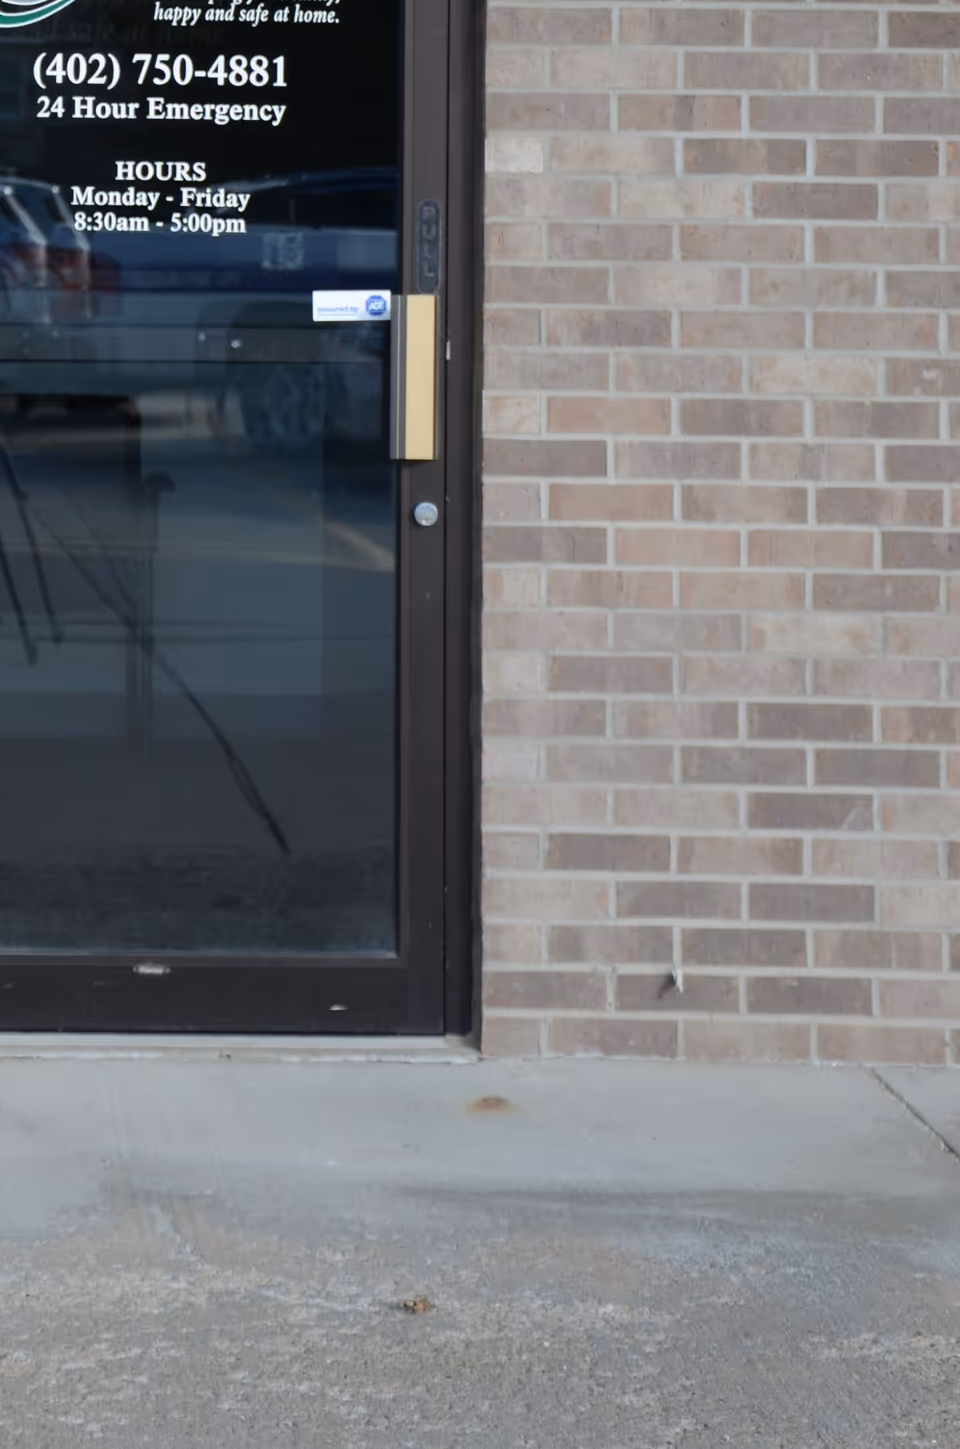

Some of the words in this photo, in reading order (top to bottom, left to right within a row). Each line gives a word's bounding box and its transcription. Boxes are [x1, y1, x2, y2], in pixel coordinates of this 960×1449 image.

[153, 1, 202, 27] happy
[205, 3, 236, 23] and
[238, 3, 270, 28] safe
[273, 6, 290, 23] at
[293, 3, 341, 24] home.
[33, 52, 121, 90] (402)
[132, 53, 287, 87] 750-4881
[36, 95, 66, 119] 24
[71, 96, 140, 120] Hour
[146, 96, 287, 127] Emergency
[114, 160, 207, 183] HOURS
[70, 185, 161, 211] Monday
[179, 187, 251, 211] Friday
[73, 211, 150, 232] 8:30am
[170, 211, 247, 237] 5:00pm
